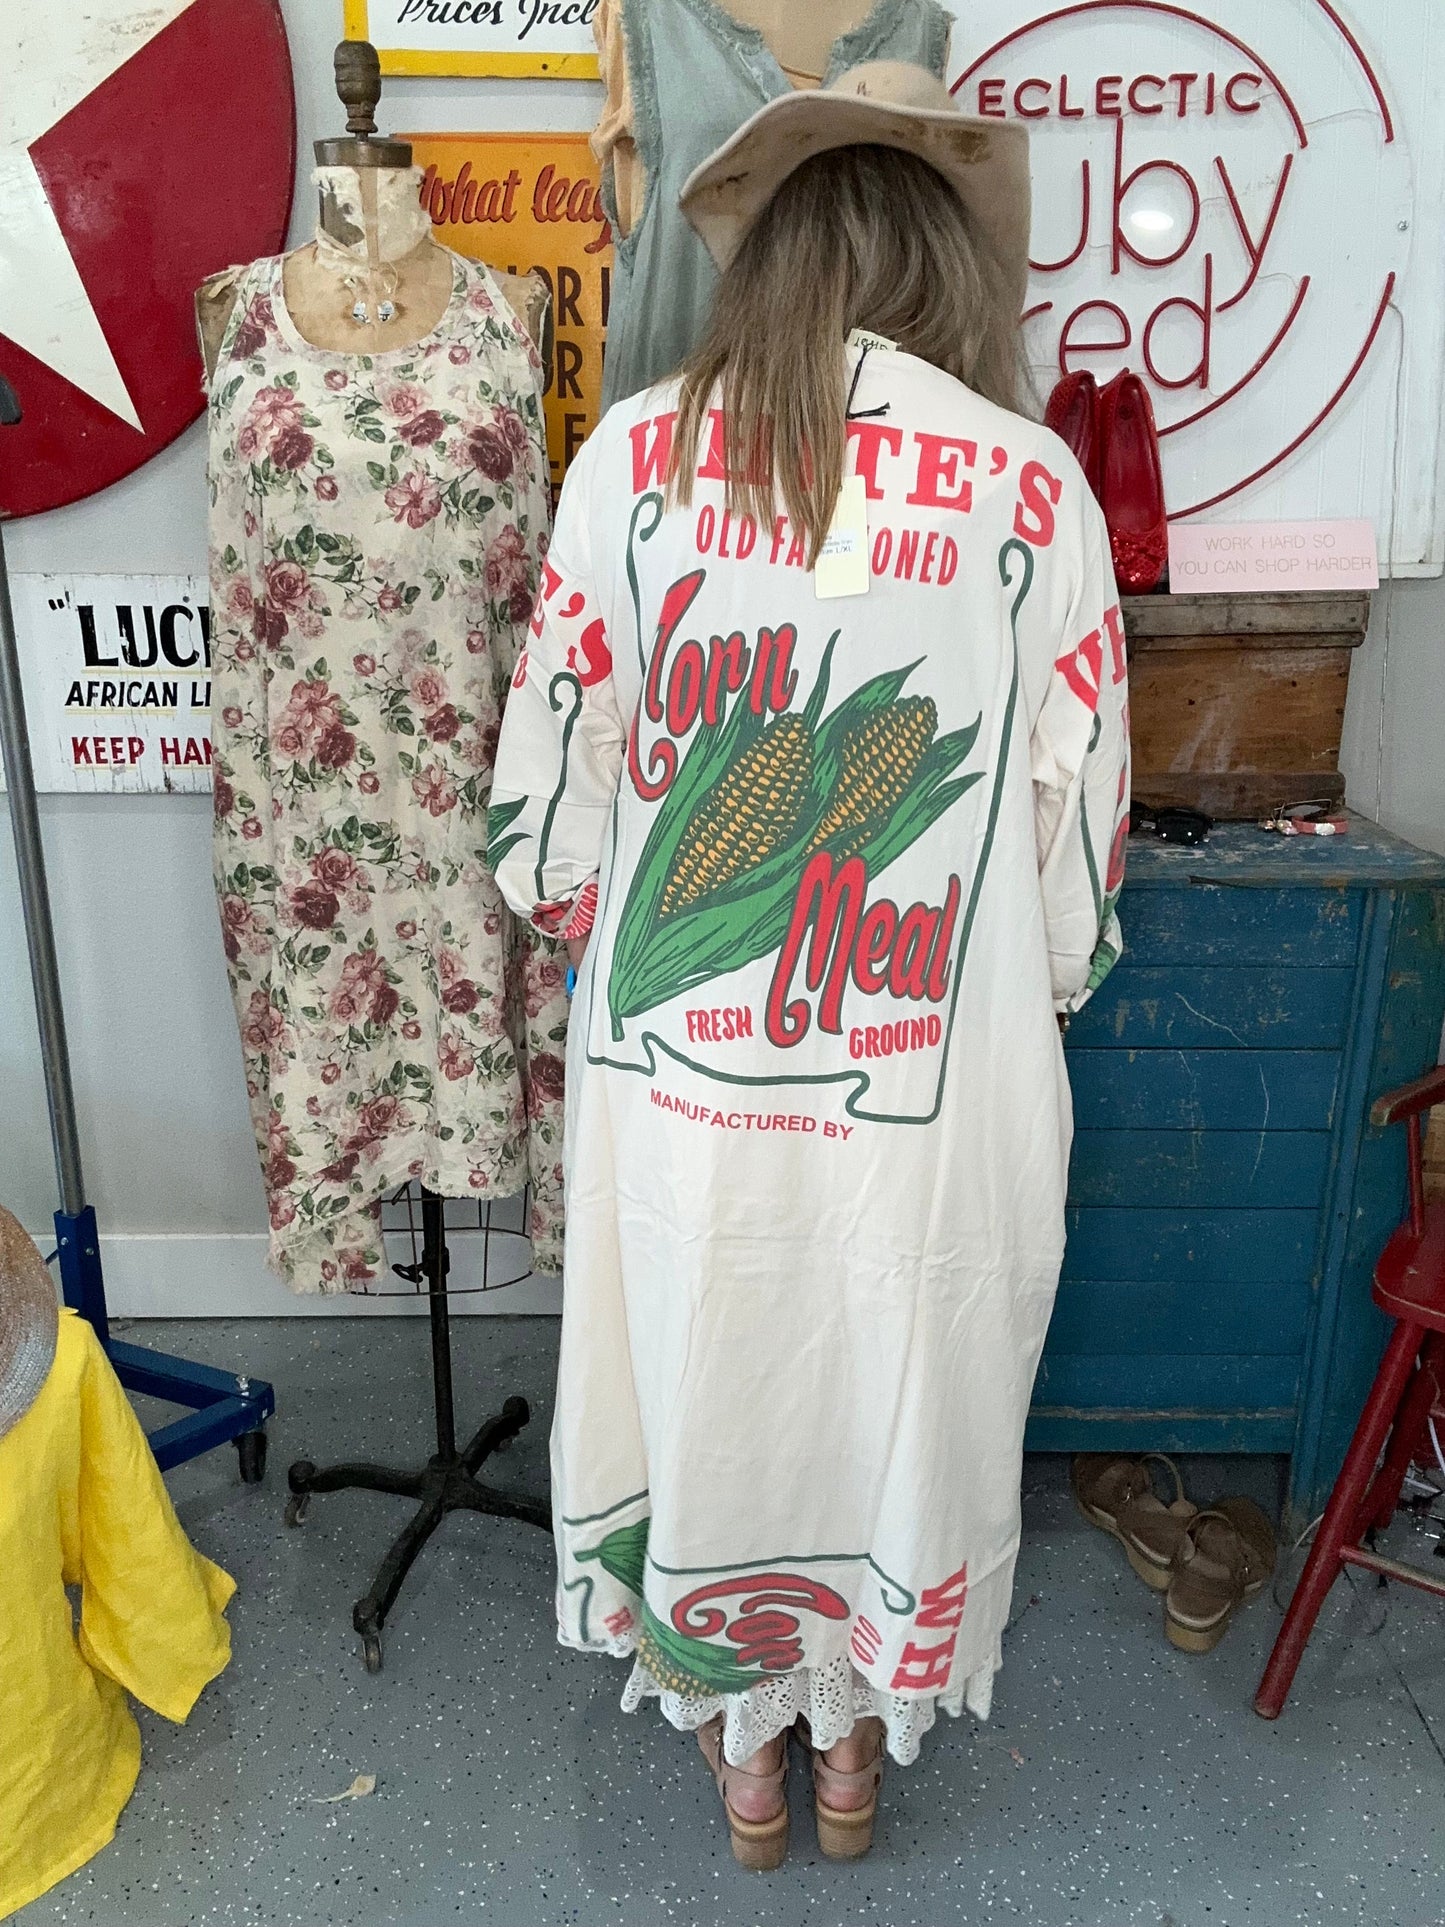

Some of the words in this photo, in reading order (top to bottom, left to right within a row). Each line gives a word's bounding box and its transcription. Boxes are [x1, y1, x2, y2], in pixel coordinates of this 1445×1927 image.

[978, 72, 1264, 118] ECLECTIC
[696, 504, 758, 560] OLD
[1204, 536, 1253, 551] WORK
[1262, 534, 1306, 550] HARD
[1312, 533, 1336, 549] SO
[1175, 559, 1208, 576] YOU
[1213, 559, 1247, 575] CAN
[1255, 557, 1301, 573] SHOP
[1306, 555, 1372, 572] HARDER
[64, 681, 178, 707] AFRICAN
[627, 568, 799, 802] Corn
[71, 736, 145, 764] KEEP
[765, 850, 962, 1048] Meal
[686, 1006, 754, 1043] FRESH
[849, 1014, 942, 1060] GROUND
[650, 1088, 817, 1133] MANUFACTURED
[823, 1120, 855, 1141] BY
